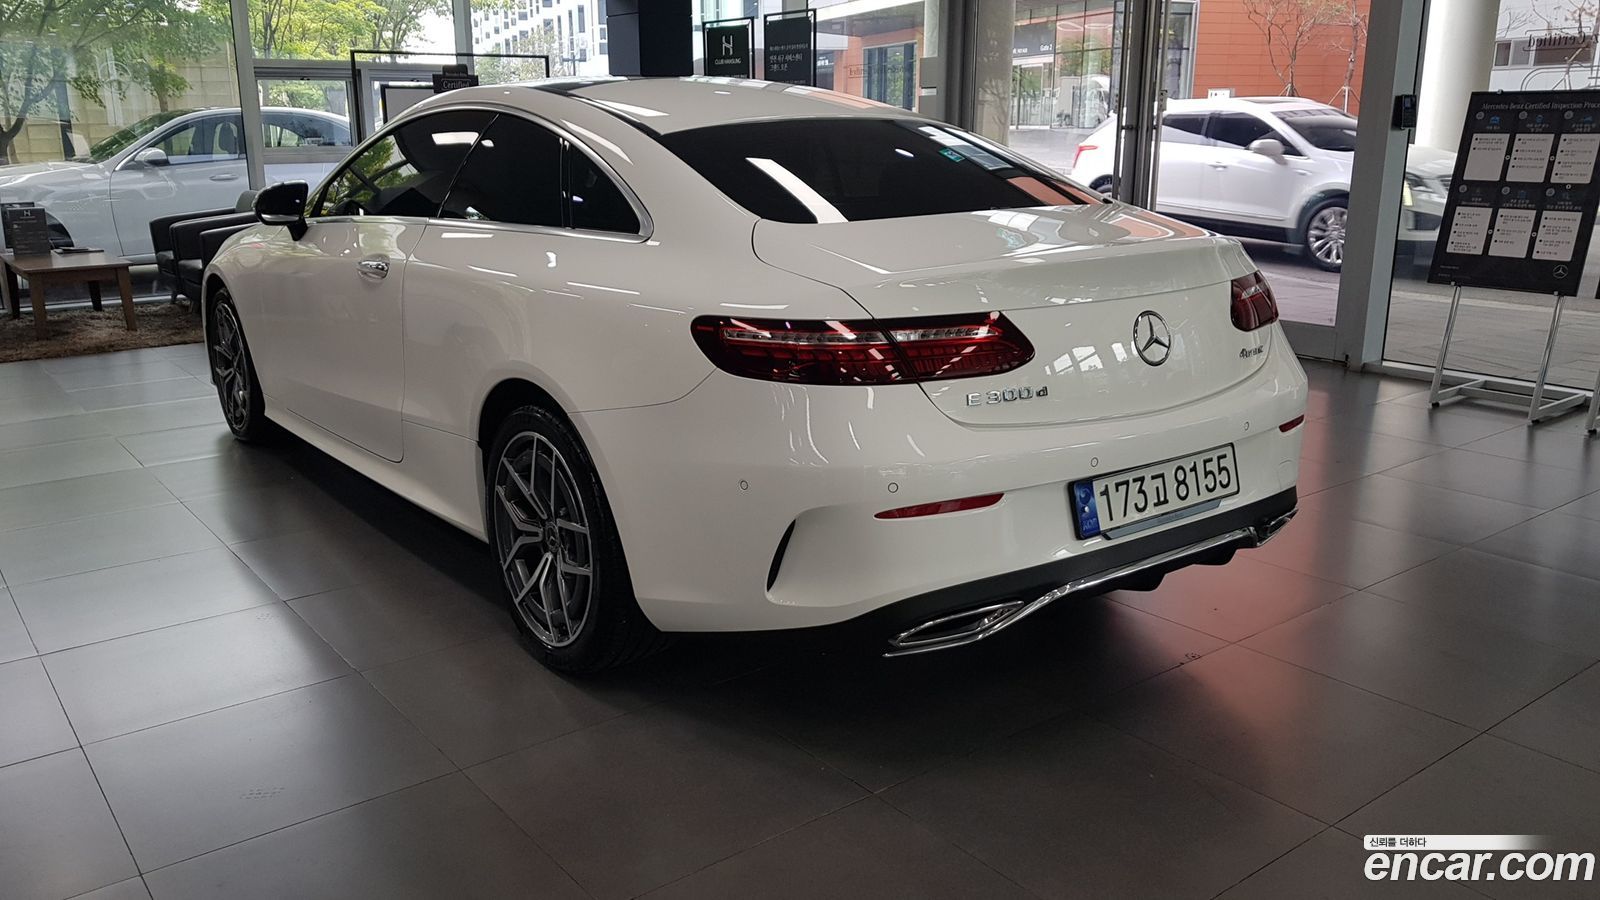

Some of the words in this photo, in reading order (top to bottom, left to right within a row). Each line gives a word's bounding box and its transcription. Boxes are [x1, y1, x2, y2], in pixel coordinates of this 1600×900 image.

[443, 81, 470, 89] Certified
[1525, 102, 1551, 110] Certified
[1099, 472, 1170, 522] 173고
[1174, 453, 1232, 502] 8155
